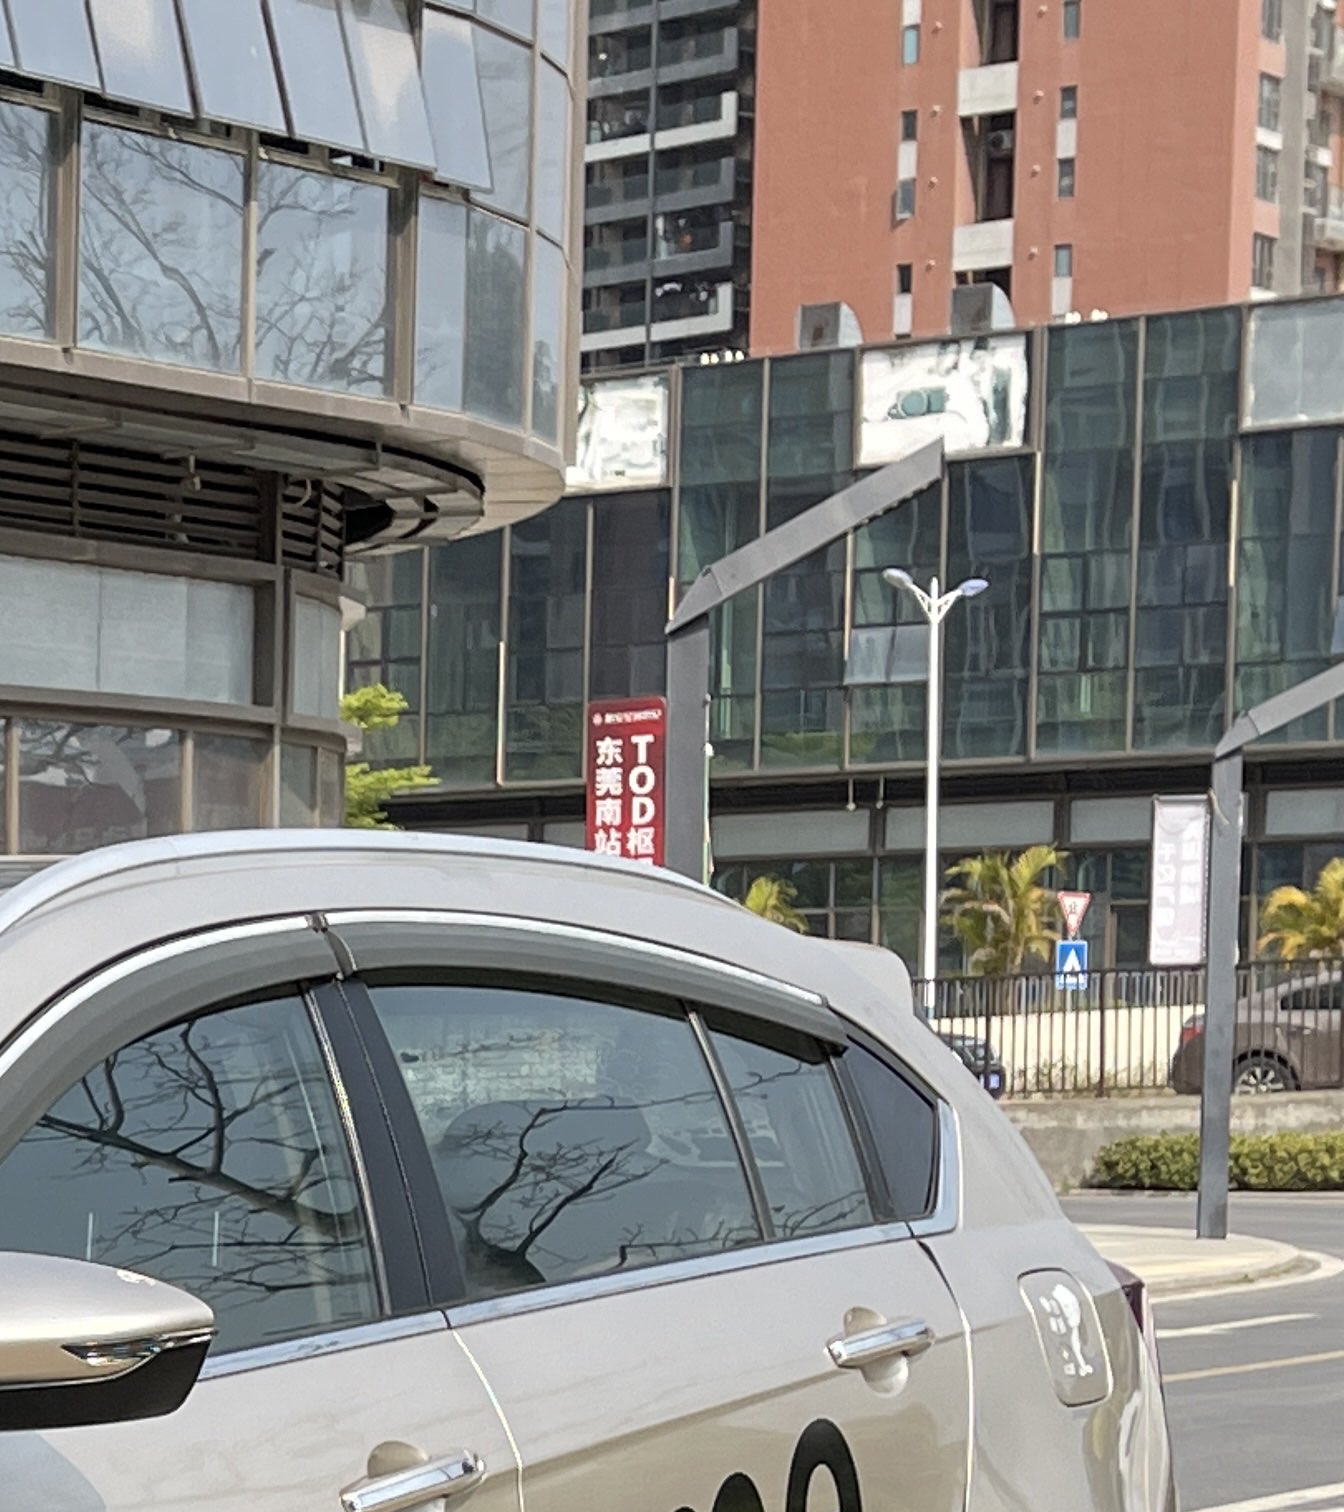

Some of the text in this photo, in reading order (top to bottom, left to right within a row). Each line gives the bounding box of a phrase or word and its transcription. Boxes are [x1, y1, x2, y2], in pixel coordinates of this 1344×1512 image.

[593, 735, 624, 856] 东莞南站
[626, 734, 656, 866] TOD枢
